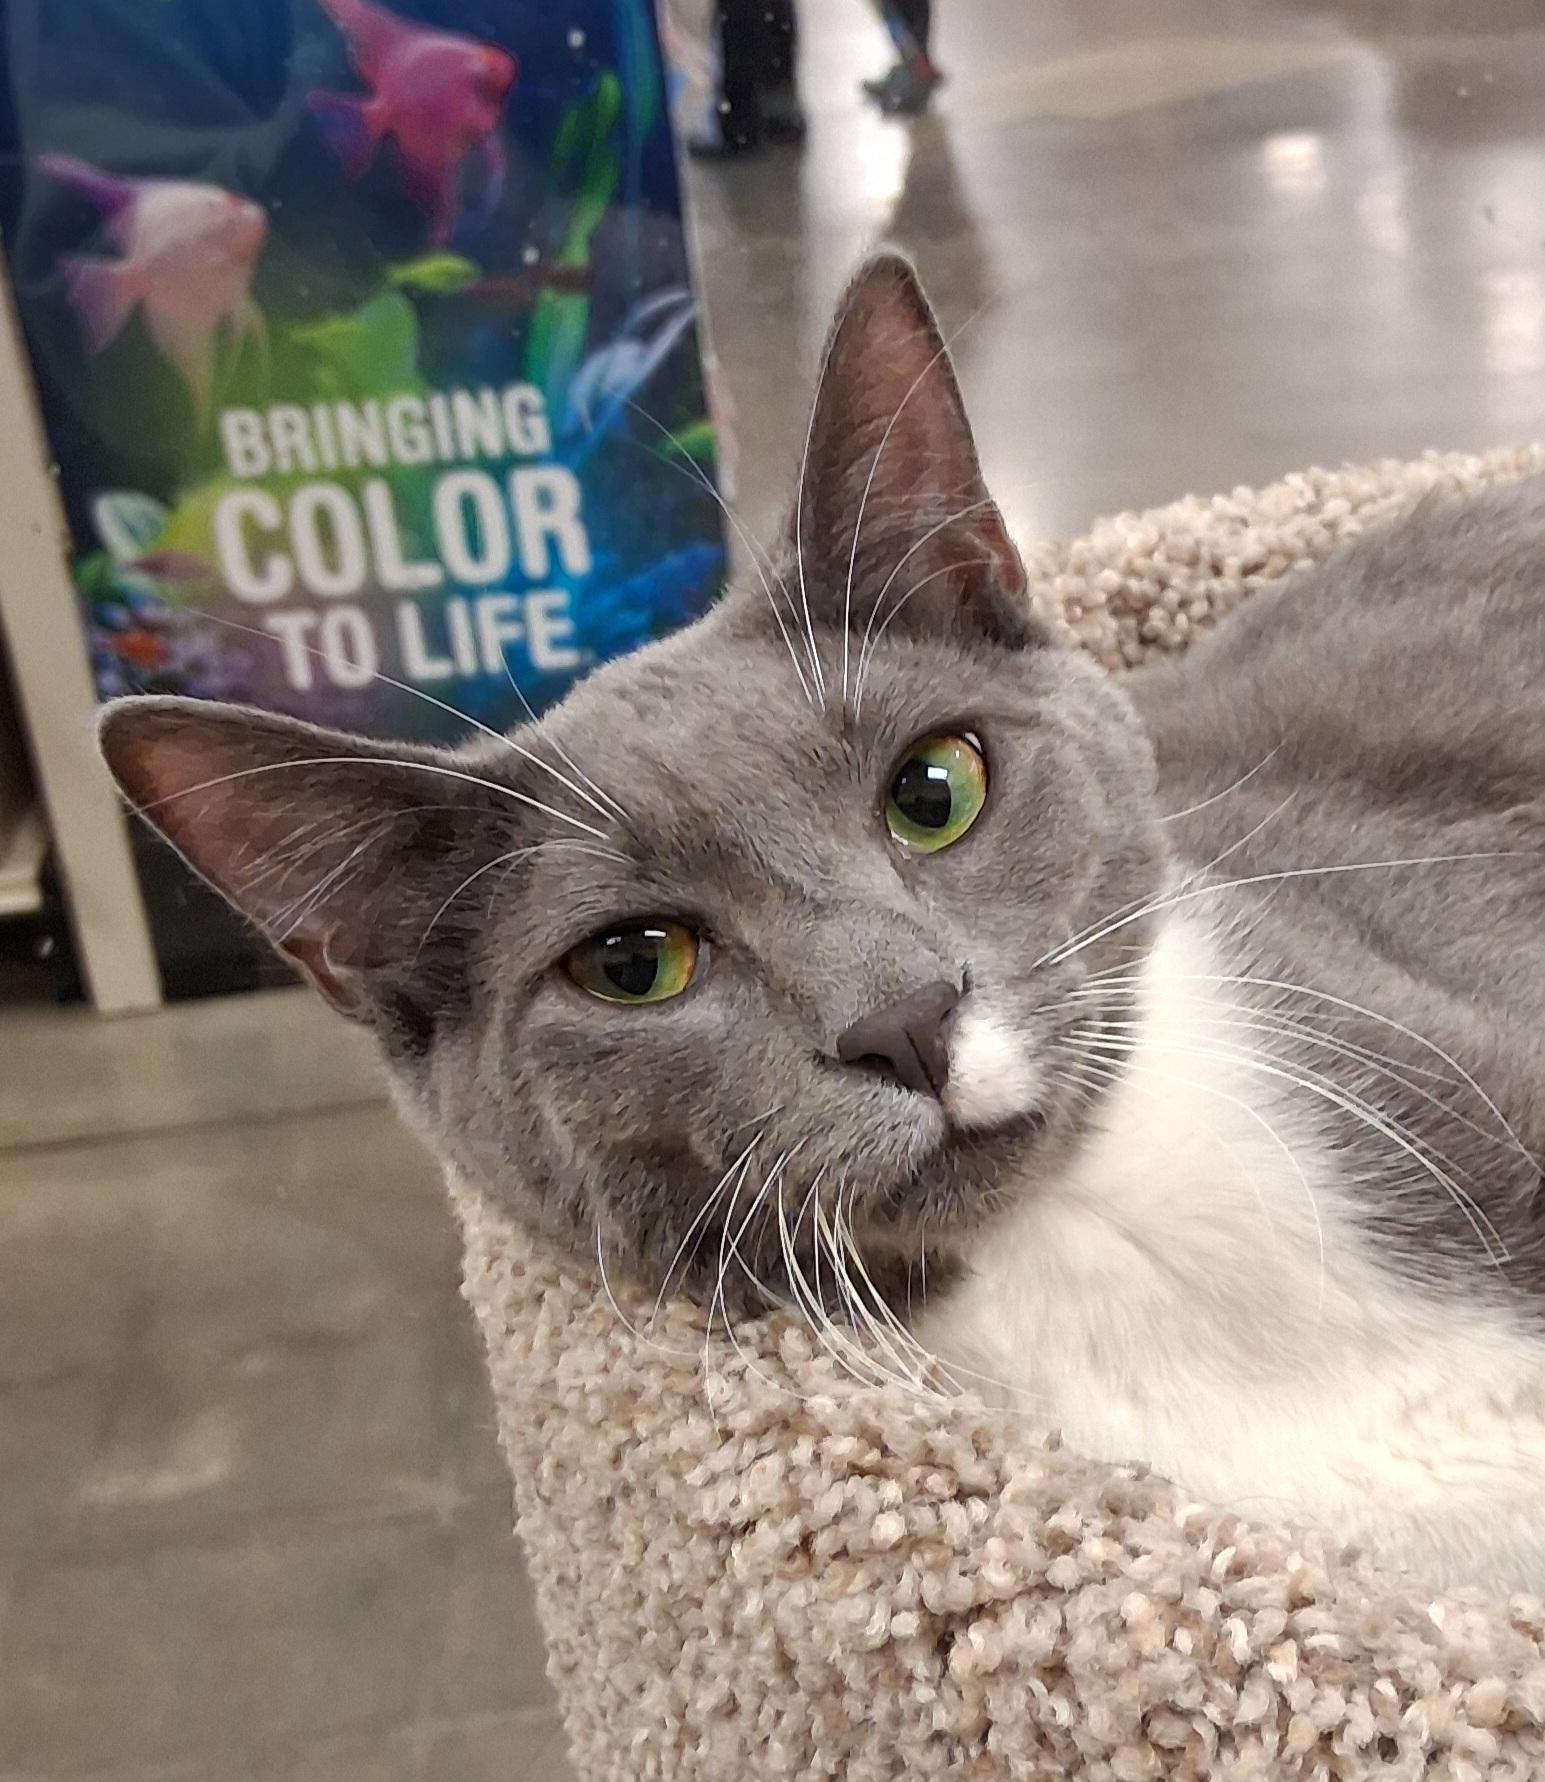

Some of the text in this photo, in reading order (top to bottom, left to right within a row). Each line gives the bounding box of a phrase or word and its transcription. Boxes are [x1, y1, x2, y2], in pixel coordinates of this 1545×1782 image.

[219, 383, 552, 478] BRINGING
[214, 465, 592, 603] COLOR
[264, 589, 583, 691] TO LIFE
